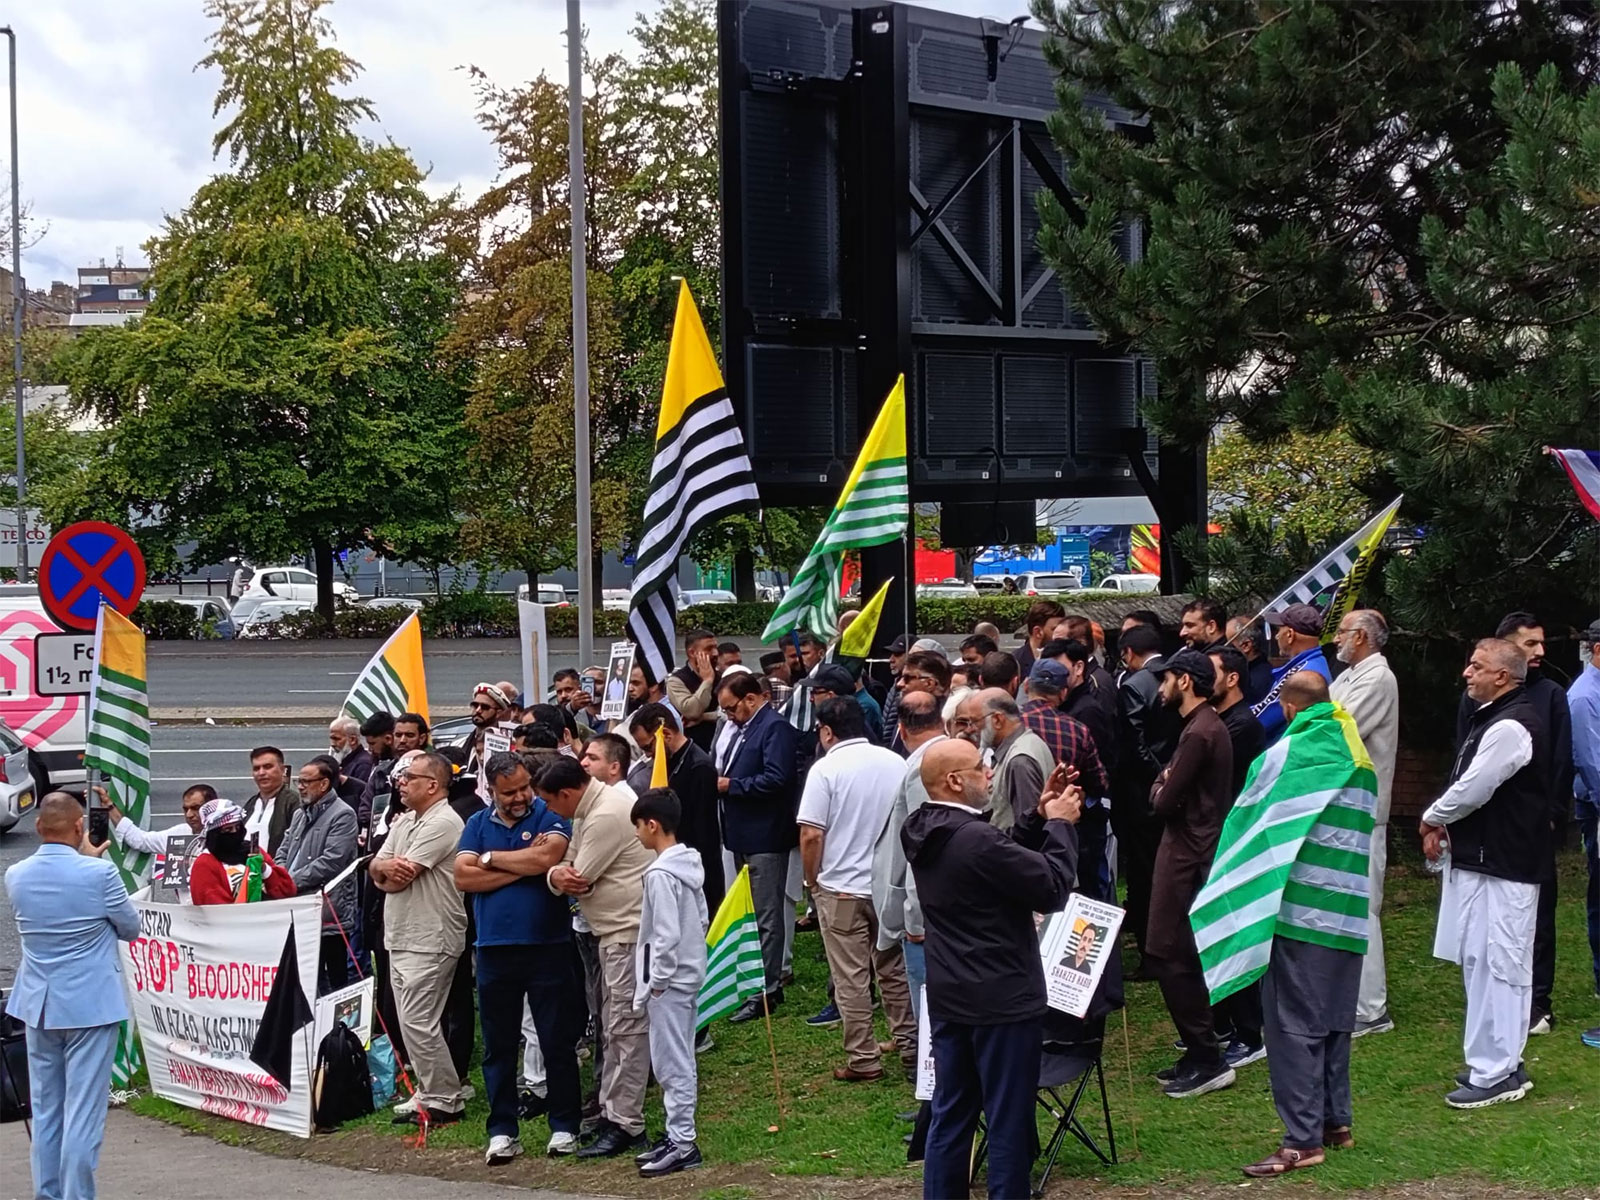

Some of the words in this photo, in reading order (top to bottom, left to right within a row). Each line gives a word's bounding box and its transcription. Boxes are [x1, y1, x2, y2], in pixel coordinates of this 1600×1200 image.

[1, 530, 45, 540] TECO
[74, 643, 95, 660] Fo
[138, 909, 171, 937] ISTAN
[129, 937, 180, 993] STOP
[180, 945, 194, 962] THE
[151, 1005, 168, 1036] IN
[166, 1007, 199, 1044] AZAD
